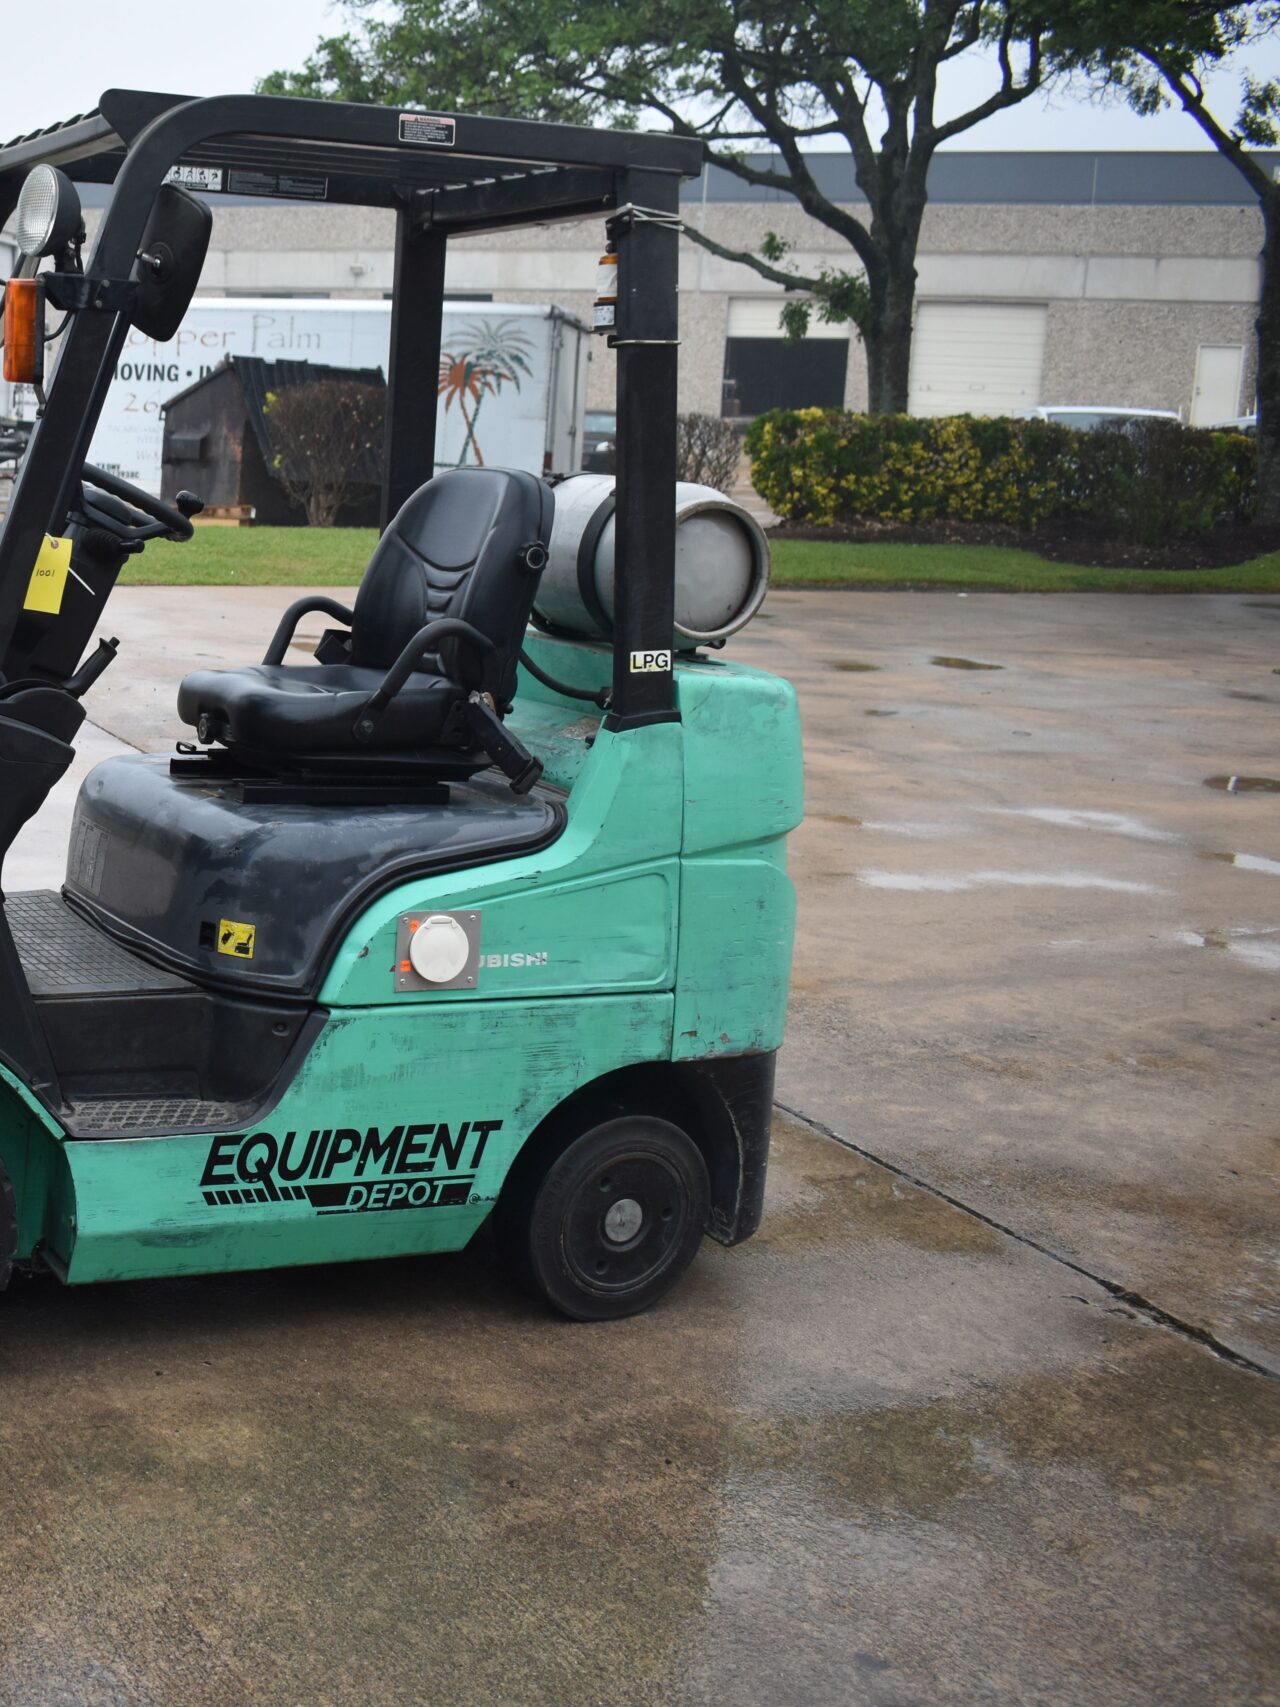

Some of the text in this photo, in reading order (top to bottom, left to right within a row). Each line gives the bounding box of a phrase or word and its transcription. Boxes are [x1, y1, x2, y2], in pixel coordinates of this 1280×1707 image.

[123, 314, 321, 357] oper Palm
[36, 569, 55, 577] 1001
[632, 652, 669, 669] LPG
[478, 952, 548, 968] BISHI
[200, 1120, 503, 1200] EQUIPMENT
[344, 1181, 446, 1210] DEPOT
